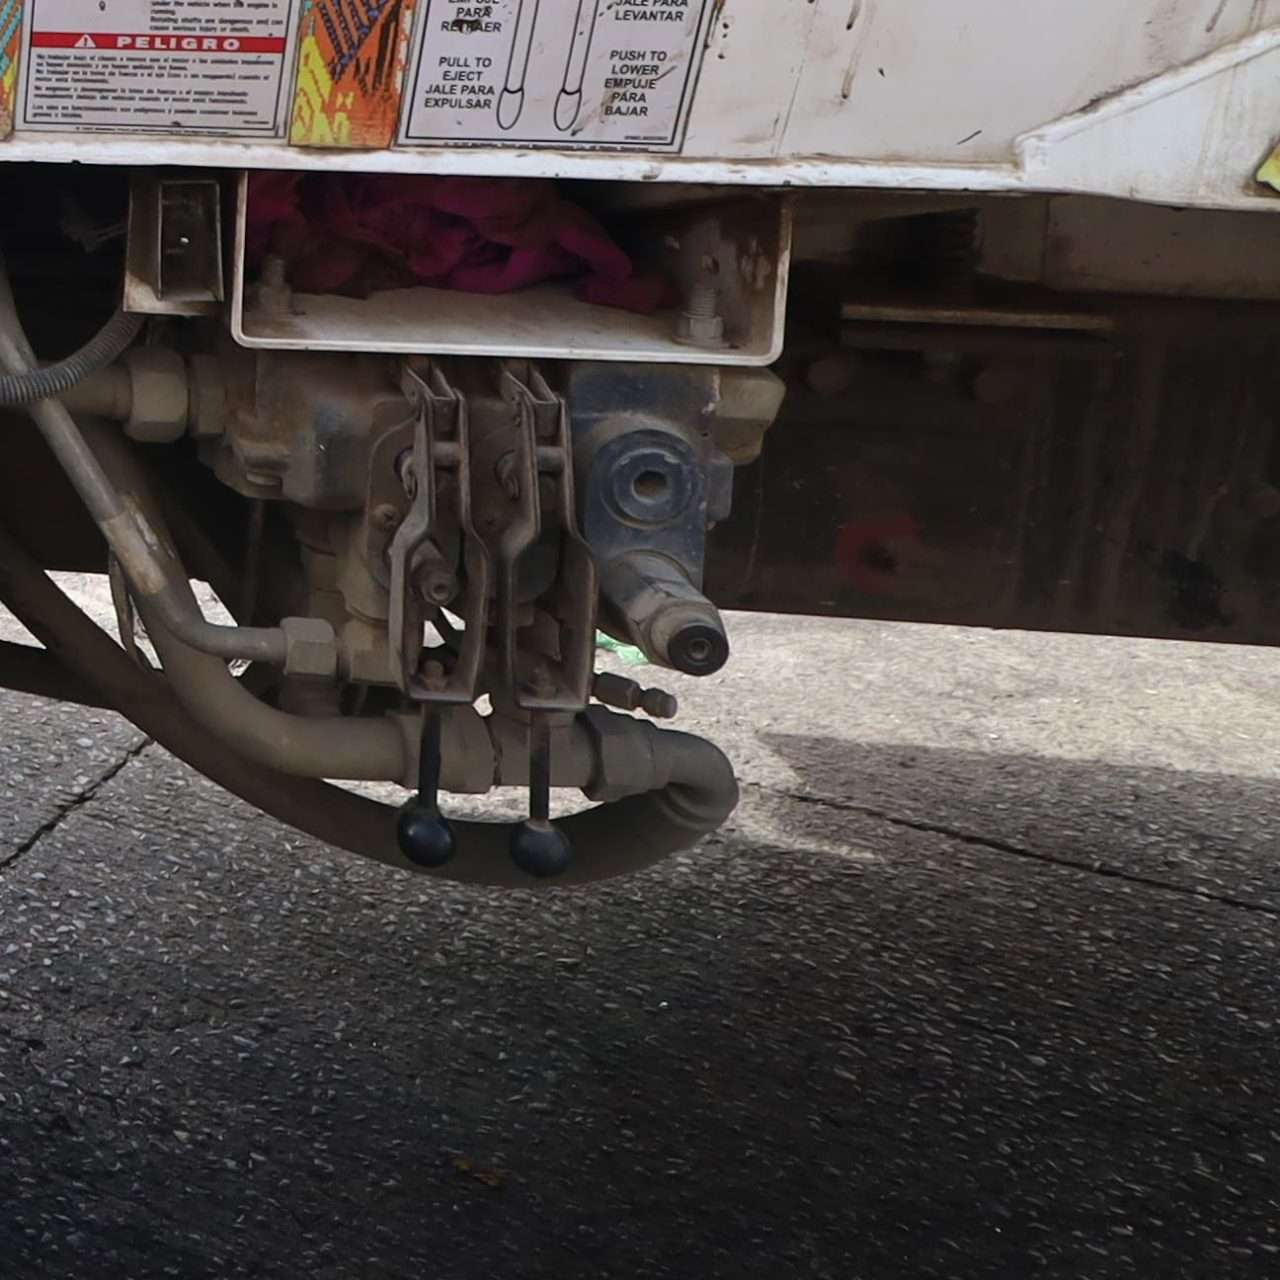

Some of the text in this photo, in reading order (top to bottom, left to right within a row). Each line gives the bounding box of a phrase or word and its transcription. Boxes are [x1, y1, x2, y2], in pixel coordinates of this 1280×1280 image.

[456, 7, 492, 18] PARA
[615, 11, 684, 21] LEVANTAR
[116, 36, 240, 50] PELIGRO
[610, 50, 667, 61] PUSH TO
[438, 57, 492, 68] PULL TO
[612, 64, 660, 75] LOWER
[443, 71, 484, 81] EJECT
[605, 78, 656, 89] EMPUJE
[425, 85, 495, 95] JALE PARA
[424, 98, 492, 108] EXPULSAR
[612, 92, 647, 103] PARA
[605, 106, 648, 116] BAJAR
